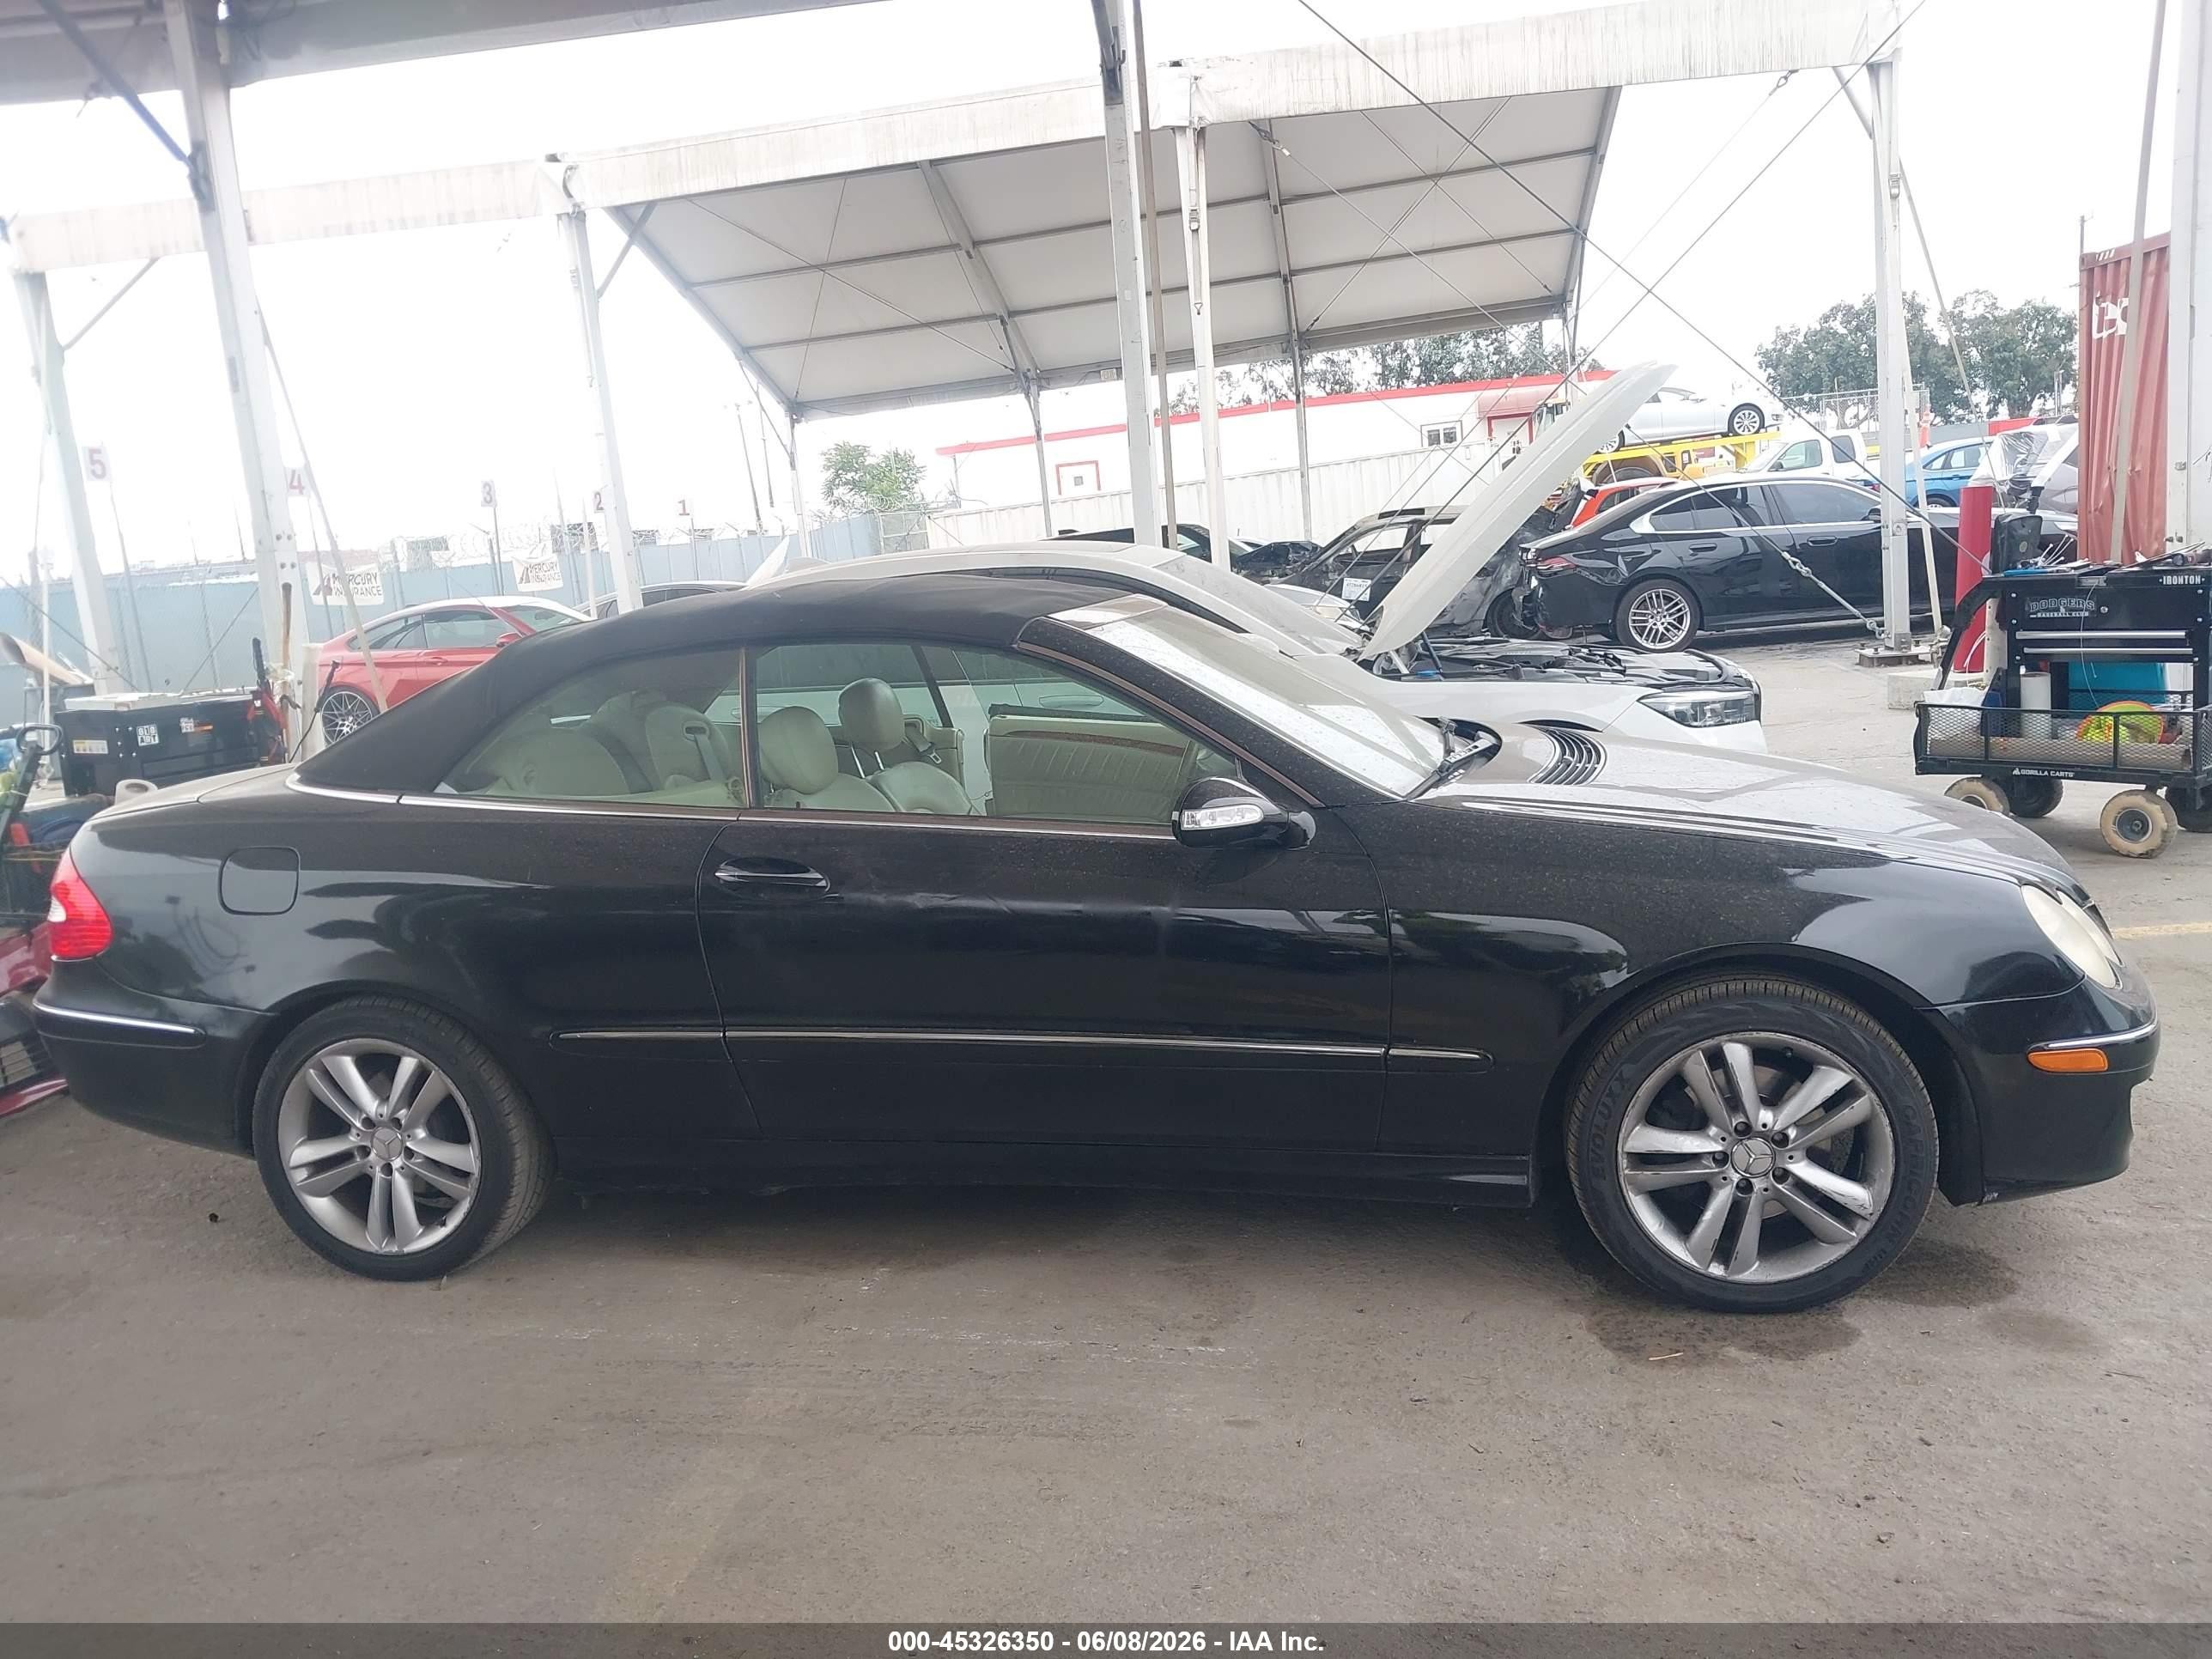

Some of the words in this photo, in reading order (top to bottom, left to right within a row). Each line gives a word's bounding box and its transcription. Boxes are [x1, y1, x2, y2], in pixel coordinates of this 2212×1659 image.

[88, 447, 107, 480] 5
[288, 469, 305, 495] 4
[481, 481, 494, 505] 3
[593, 491, 605, 511] 2
[678, 499, 690, 516] 1
[528, 560, 558, 574] MERCURY
[331, 572, 378, 586] MRCURY
[2029, 598, 2095, 612] DODGERS
